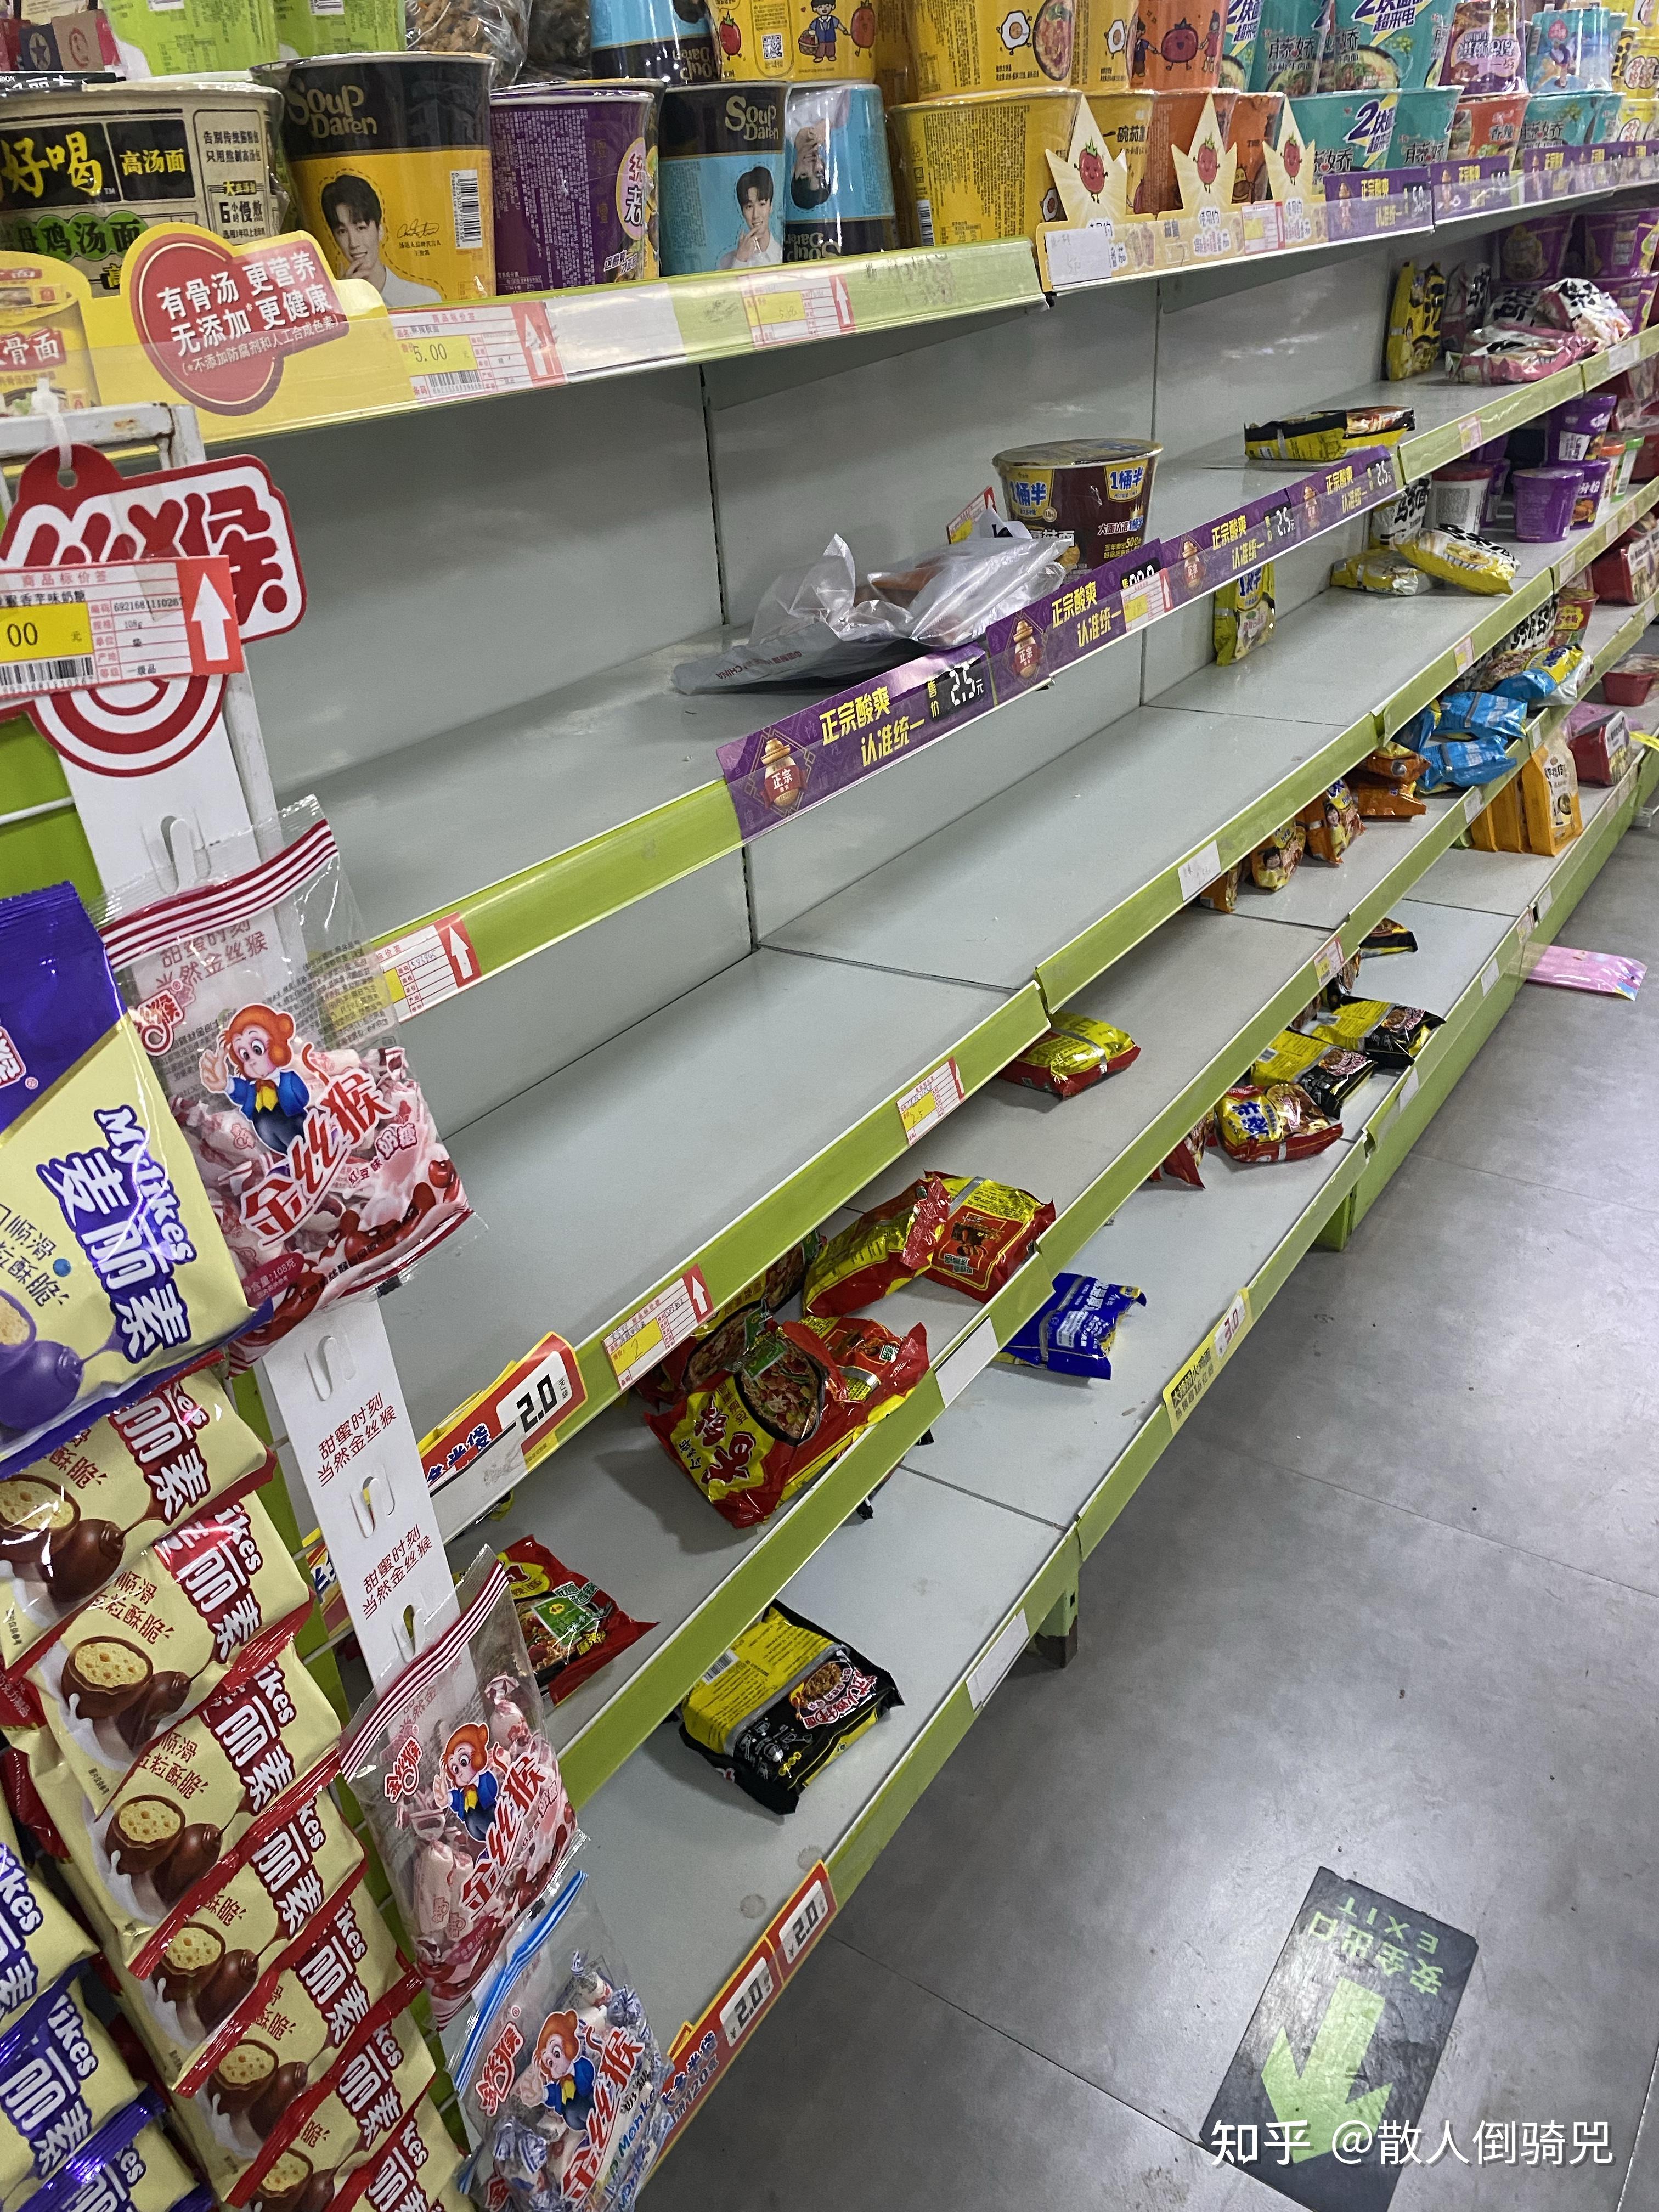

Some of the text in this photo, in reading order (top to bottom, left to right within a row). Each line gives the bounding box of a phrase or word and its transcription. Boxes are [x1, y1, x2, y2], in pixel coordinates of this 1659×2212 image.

[286, 84, 365, 126] Soup
[310, 113, 377, 139] Daren
[725, 96, 777, 131] Soup
[744, 122, 779, 141] Daren
[1, 131, 103, 198] 好喝
[119, 148, 186, 175] 高汤面
[4, 219, 140, 256] 母鸡汤面
[157, 251, 317, 321] 有骨汤 更营养
[0, 332, 60, 367] 骨面
[170, 283, 333, 357] 无添加 更健康
[413, 342, 447, 363] 5.00
[1211, 515, 1247, 551] 正宗酸爽
[1052, 582, 1097, 629] 正宗酸爽
[1076, 607, 1123, 649] 认准统一
[716, 665, 743, 680] CHINA
[819, 686, 891, 746] 正宗酸爽
[861, 718, 926, 768] 认准统一
[772, 768, 793, 791] 正宗
[243, 1073, 394, 1241] 金丝猴
[348, 1122, 419, 1187] 红豆味 奶糖
[100, 1108, 194, 1263] Mylikes
[48, 1153, 187, 1359] 麦丽素
[318, 1391, 384, 1452] 甜蜜时刻
[516, 1374, 558, 1432] 2.0
[317, 1404, 397, 1487] 当然金丝猴
[224, 1504, 263, 1571] ikes
[363, 1523, 421, 1595] 甜蜜时刻
[361, 1534, 433, 1620] 当然金丝猴
[253, 1661, 295, 1724] ikes
[462, 1755, 546, 1913] 金丝猴
[252, 1824, 323, 1935] 丽素
[793, 1901, 819, 1945] 2.0
[1309, 1911, 1444, 1996] 安全出口
[1339, 1896, 1438, 1954] EXIT
[301, 1935, 371, 2045] 丽素
[734, 1986, 764, 2028] 2.0
[5, 2047, 91, 2174] 丽素
[340, 2044, 402, 2147] 丽素
[561, 2026, 645, 2205] 金丝猴
